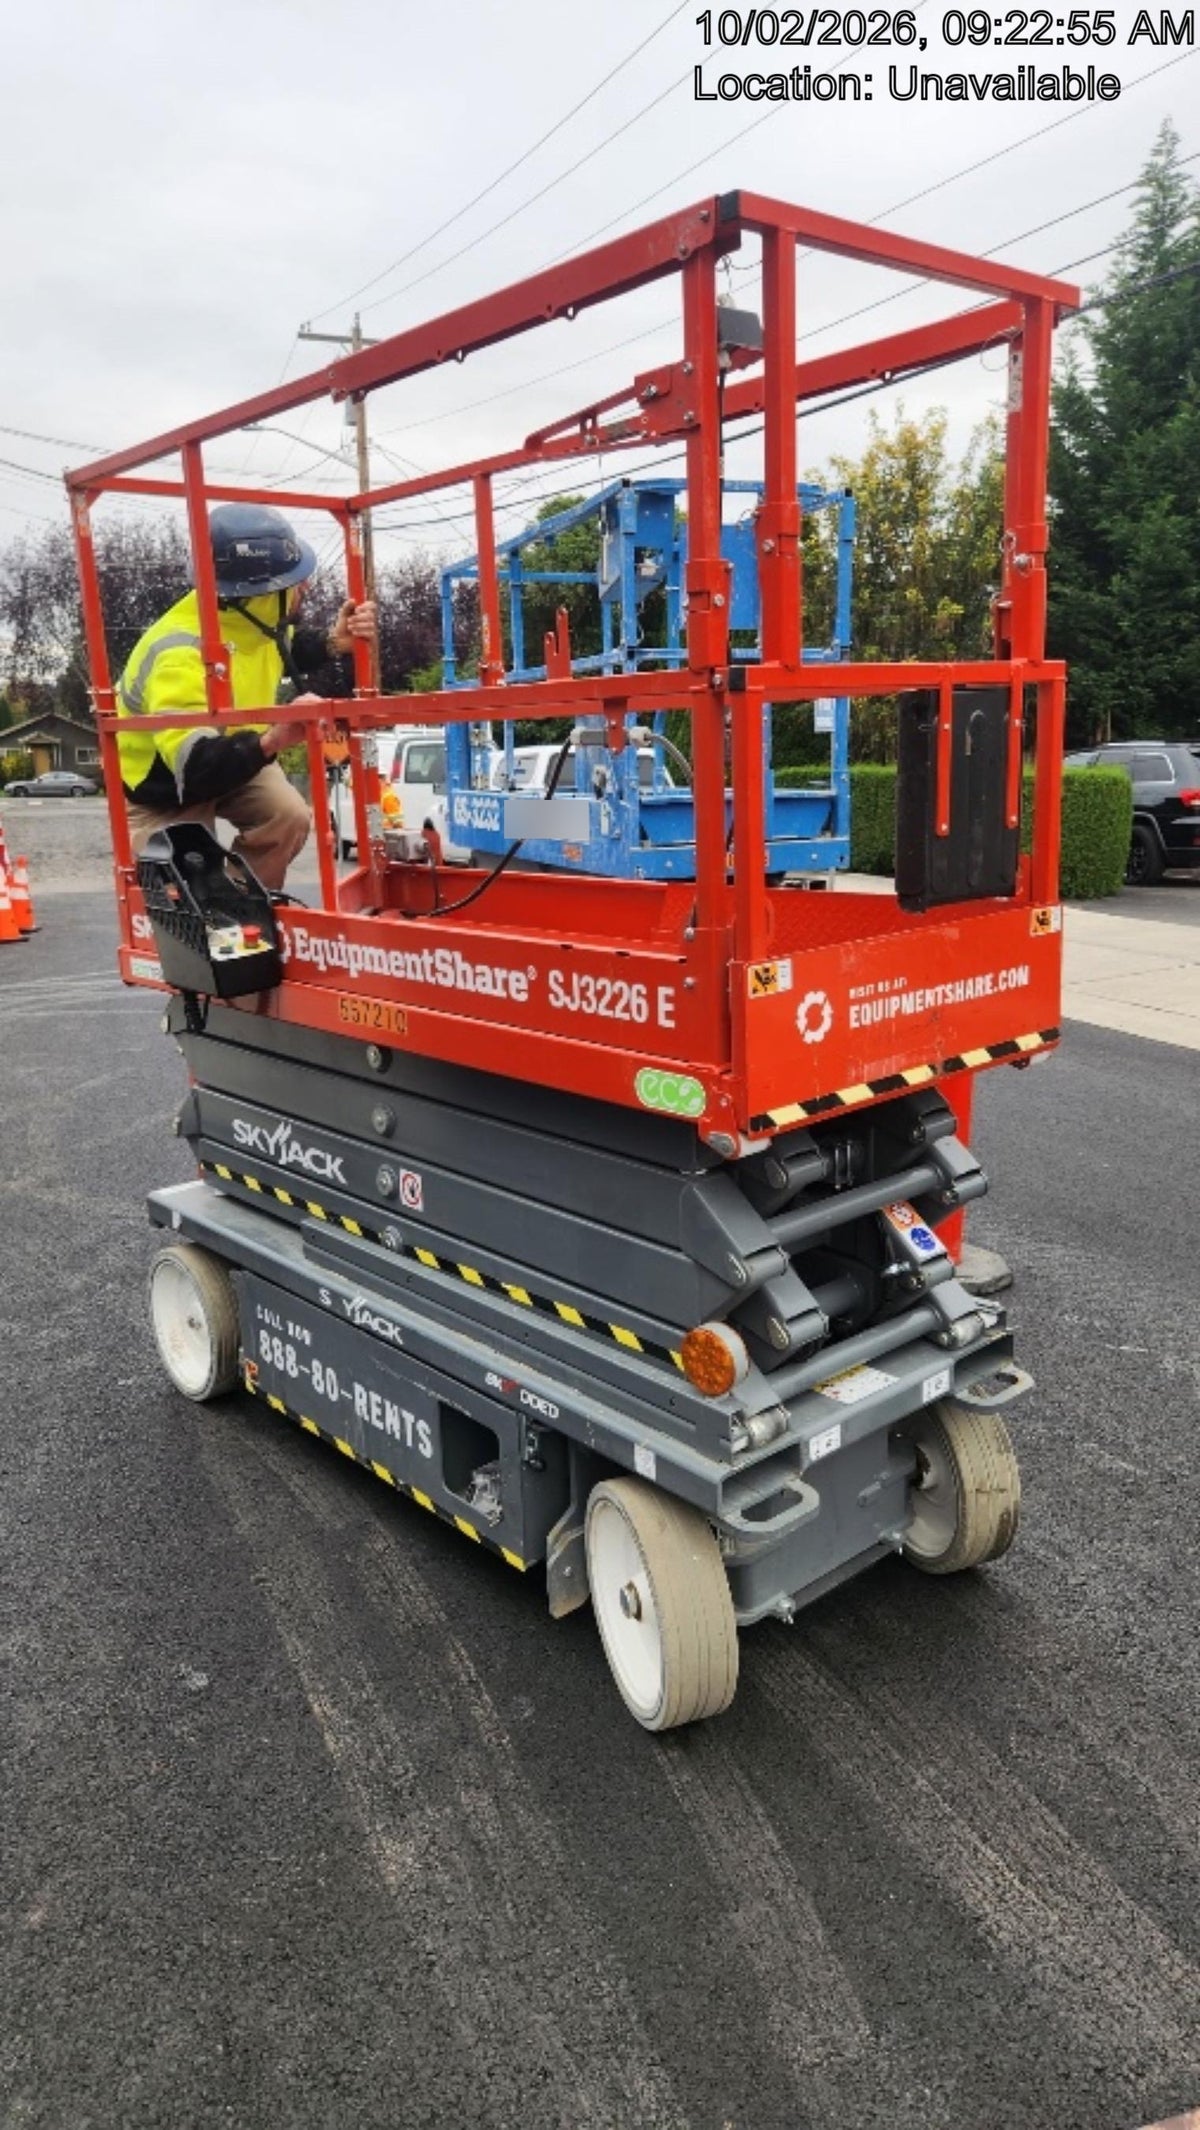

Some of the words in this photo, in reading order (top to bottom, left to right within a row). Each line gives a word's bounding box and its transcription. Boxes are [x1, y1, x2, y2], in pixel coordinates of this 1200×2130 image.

[548, 968, 649, 1024] SJ3226
[657, 986, 676, 1029] E
[849, 965, 1030, 1030] EQUIPMENTSHARE.COM
[231, 1119, 348, 1185] SKYJACK
[318, 1288, 404, 1346] SYJACK
[258, 1329, 434, 1459] 888-80-RENTS
